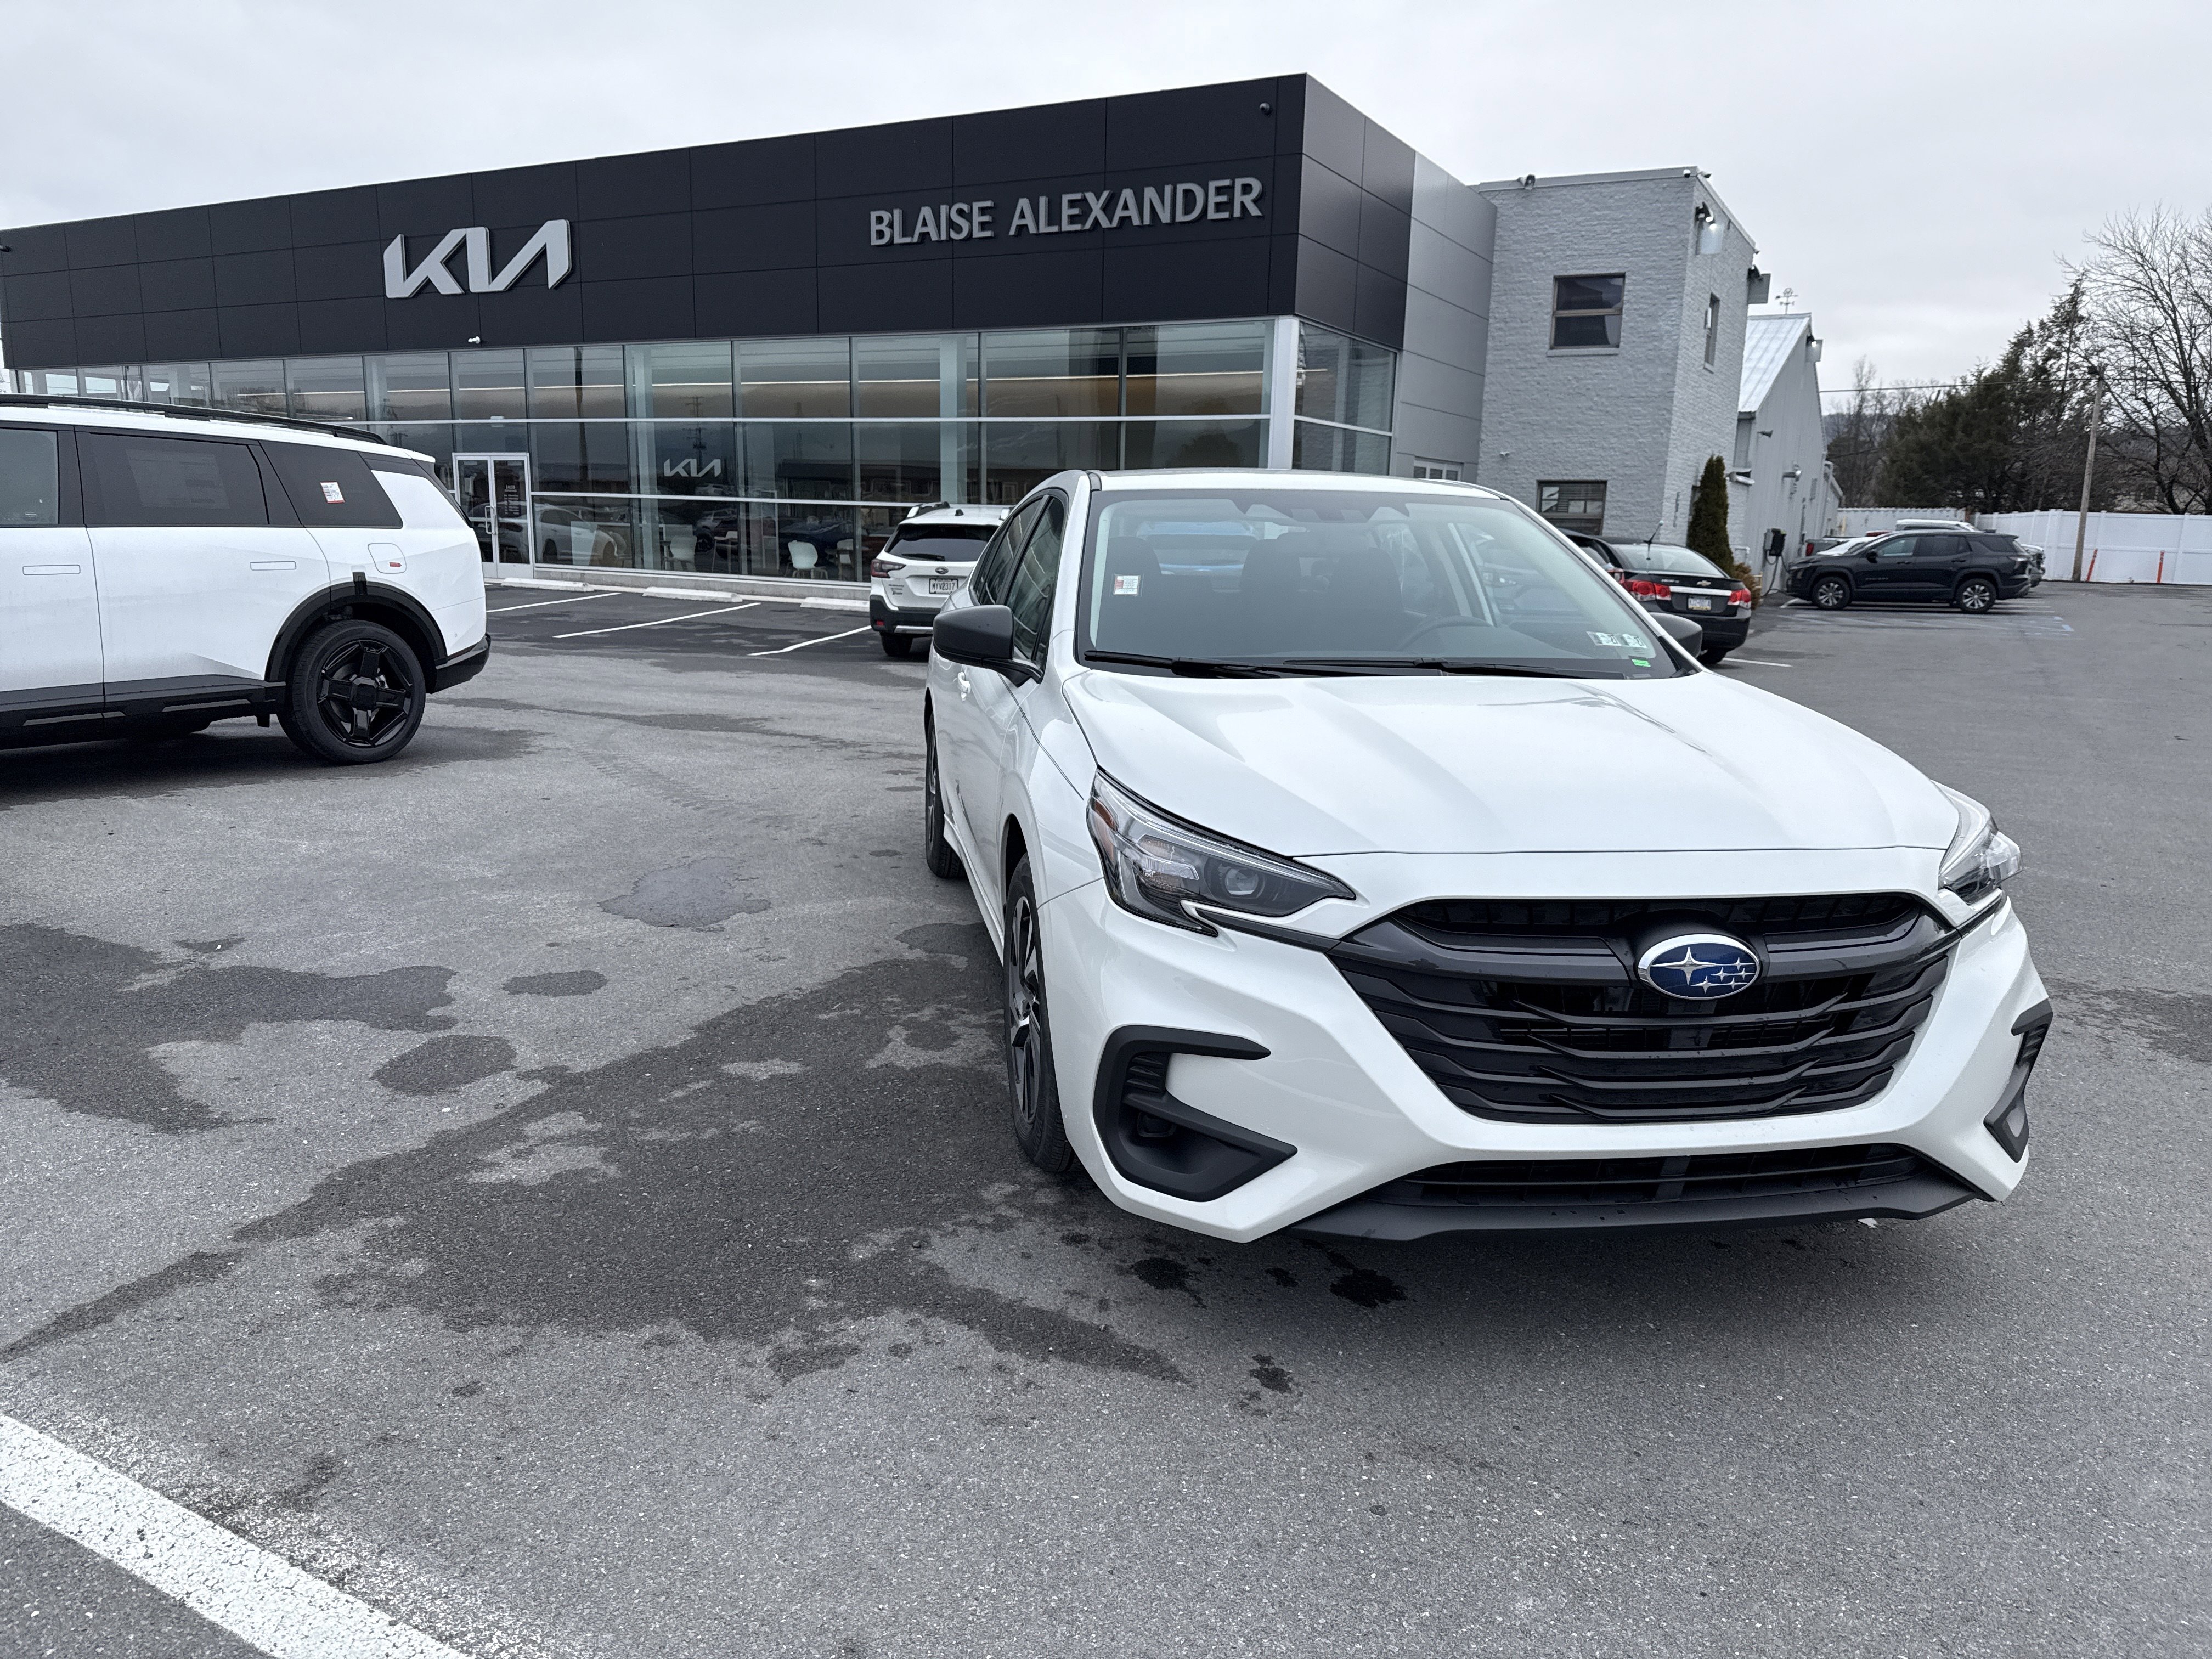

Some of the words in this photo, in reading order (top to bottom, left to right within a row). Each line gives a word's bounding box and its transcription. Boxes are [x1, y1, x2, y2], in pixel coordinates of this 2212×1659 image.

[870, 200, 995, 246] BLAISE
[1008, 177, 1263, 235] ALEXANDER
[383, 219, 572, 298] KIA
[663, 458, 721, 477] KIA
